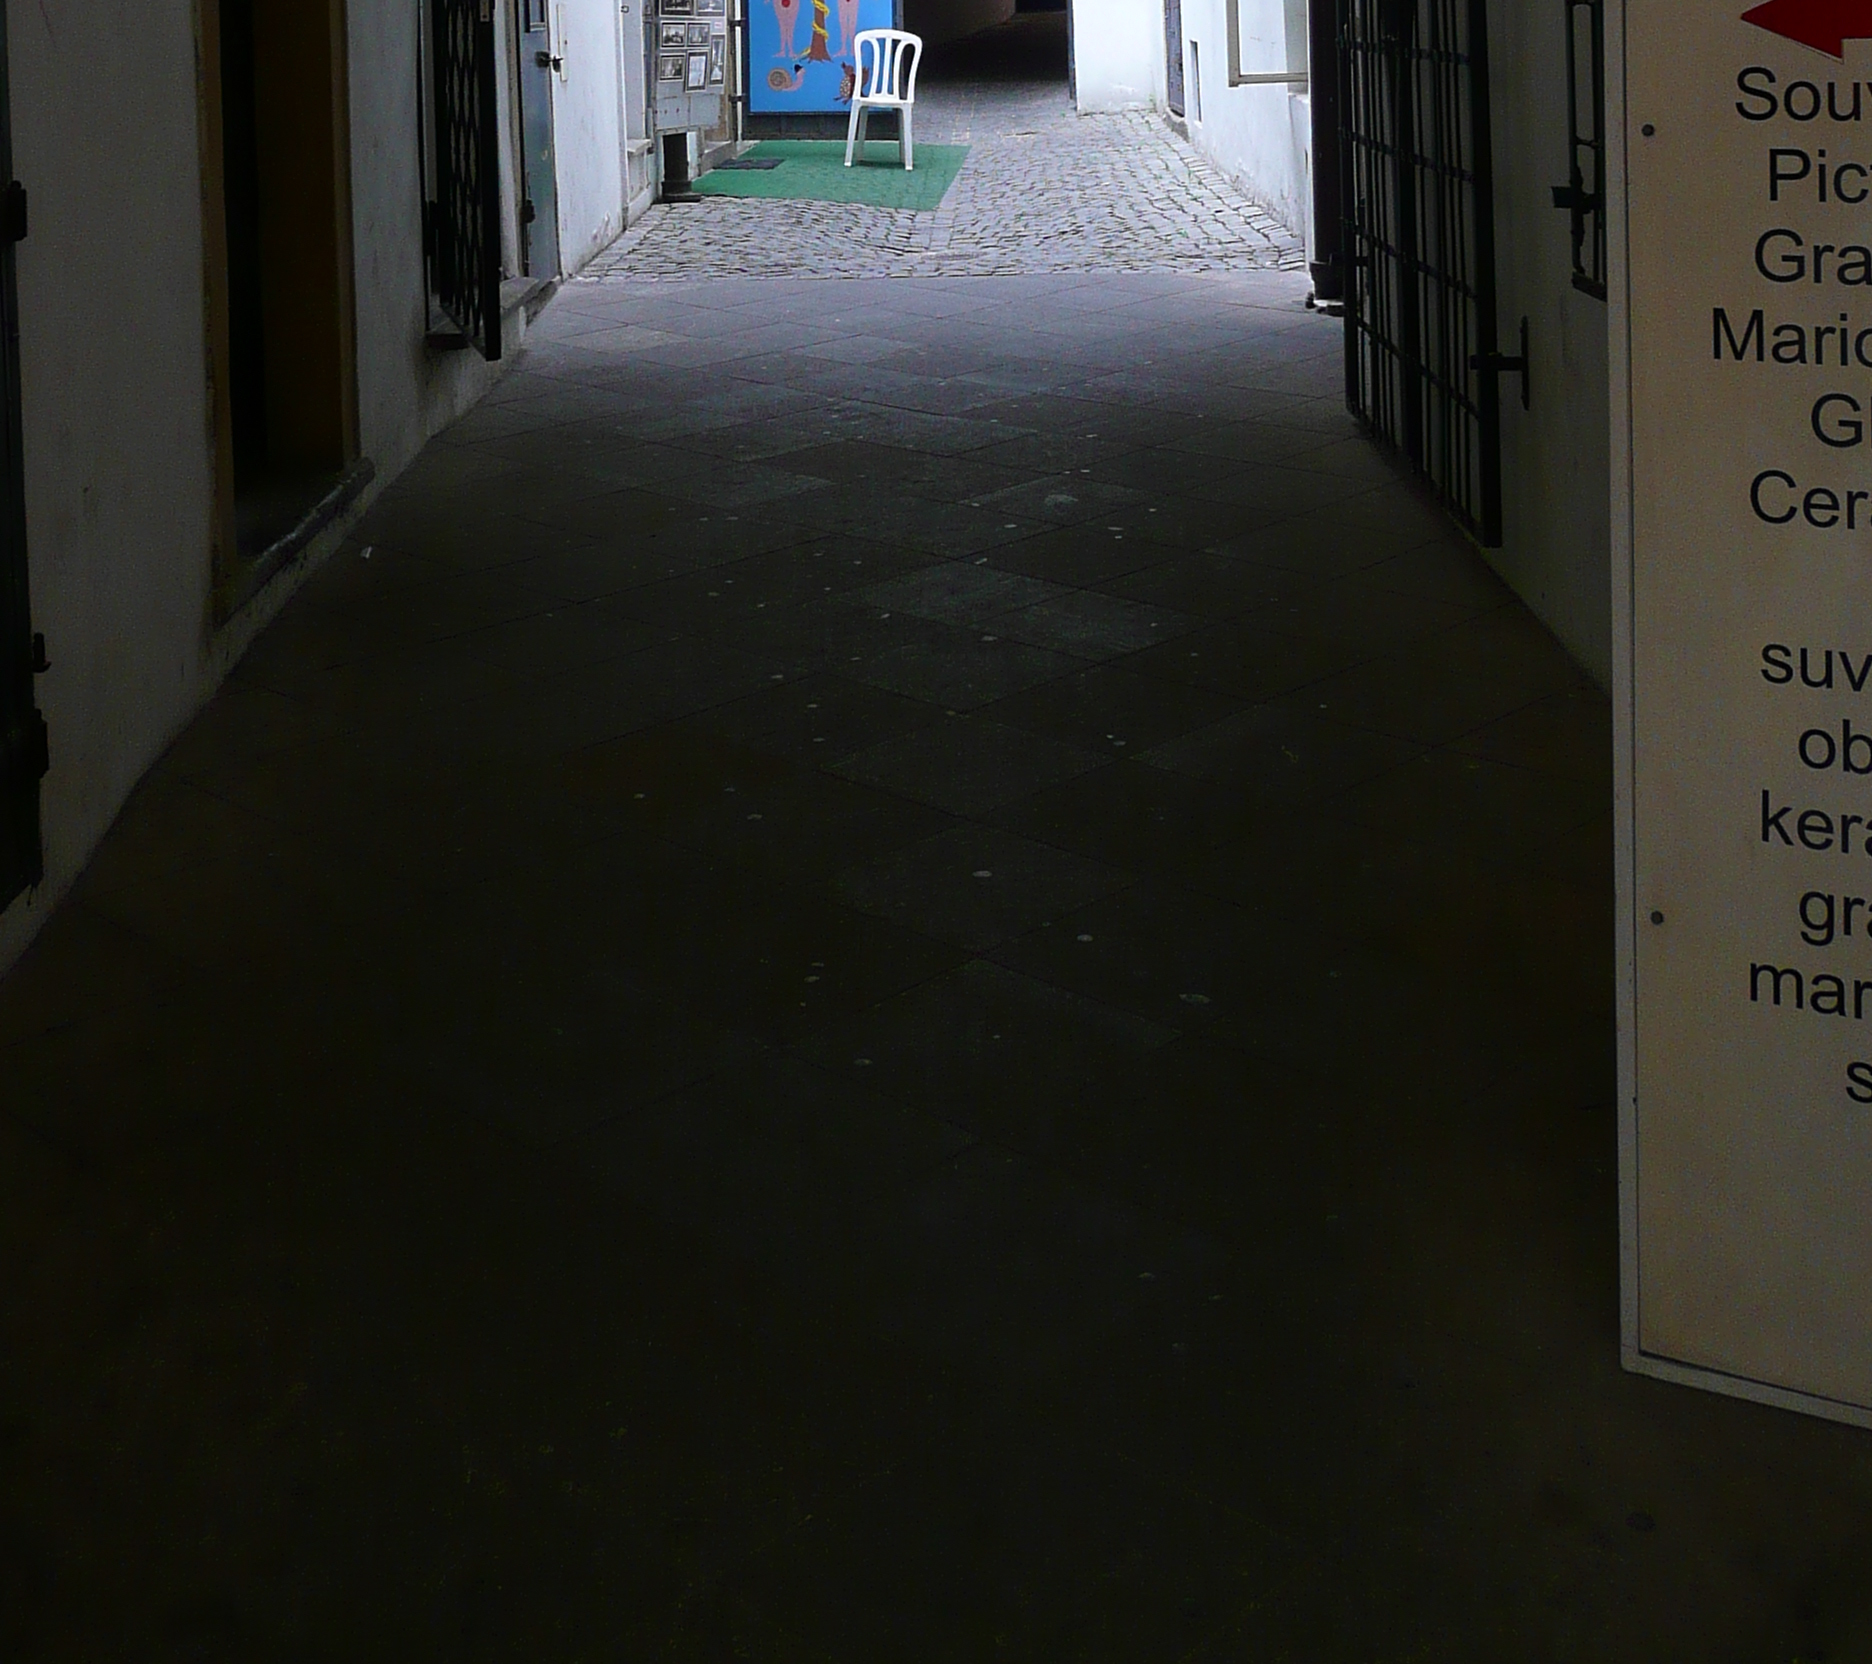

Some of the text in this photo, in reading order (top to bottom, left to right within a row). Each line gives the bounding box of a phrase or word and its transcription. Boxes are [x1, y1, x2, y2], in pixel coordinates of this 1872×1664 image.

[1736, 67, 1872, 121] Sou
[1769, 149, 1872, 203] Pic
[1755, 229, 1872, 285] Gra
[1811, 393, 1872, 448] G
[1750, 470, 1872, 529] Cer
[1761, 644, 1872, 691] suv
[1799, 719, 1872, 774] ob
[1762, 789, 1872, 858] ker
[1799, 891, 1872, 946] gr
